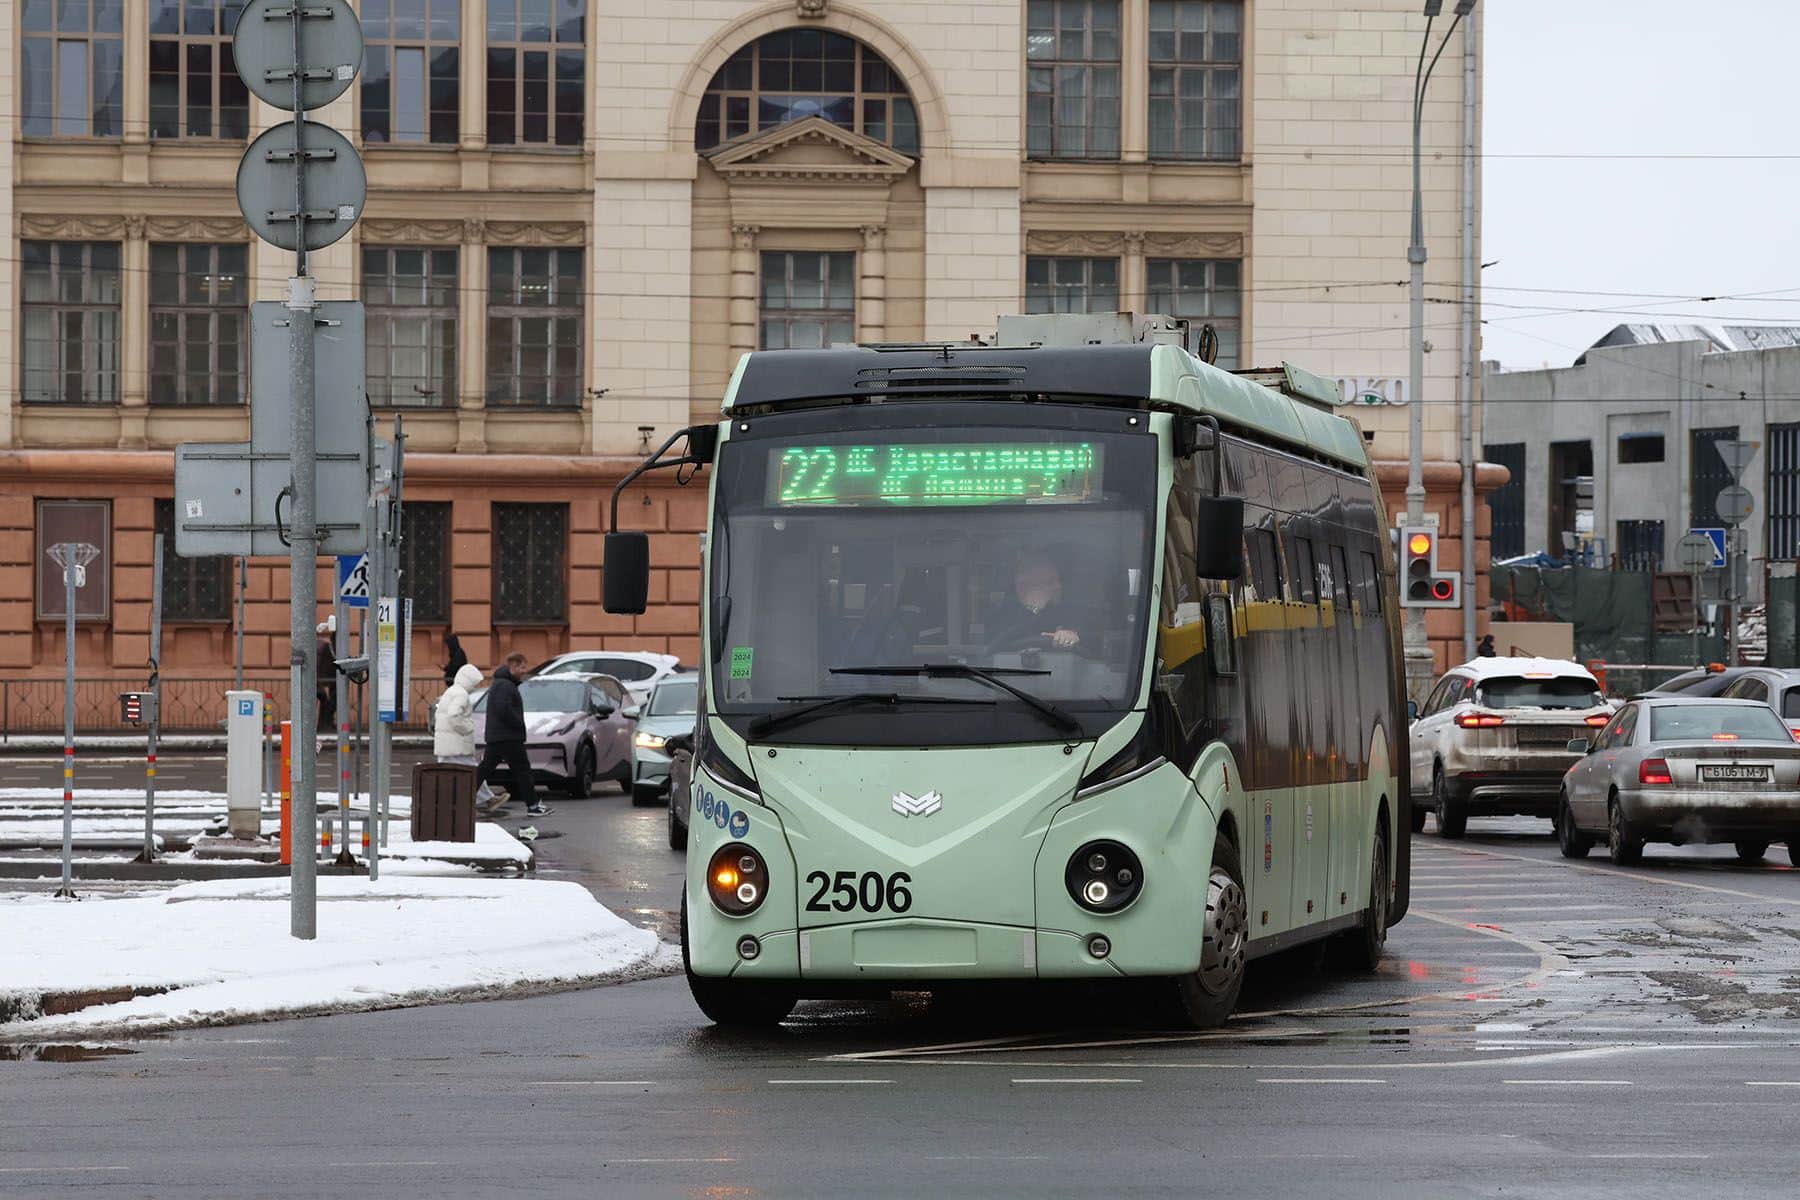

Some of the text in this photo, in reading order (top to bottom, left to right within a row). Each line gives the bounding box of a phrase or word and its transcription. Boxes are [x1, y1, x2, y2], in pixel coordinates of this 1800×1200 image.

[781, 448, 836, 502] 22
[241, 702, 252, 714] P
[805, 870, 913, 914] 2506
